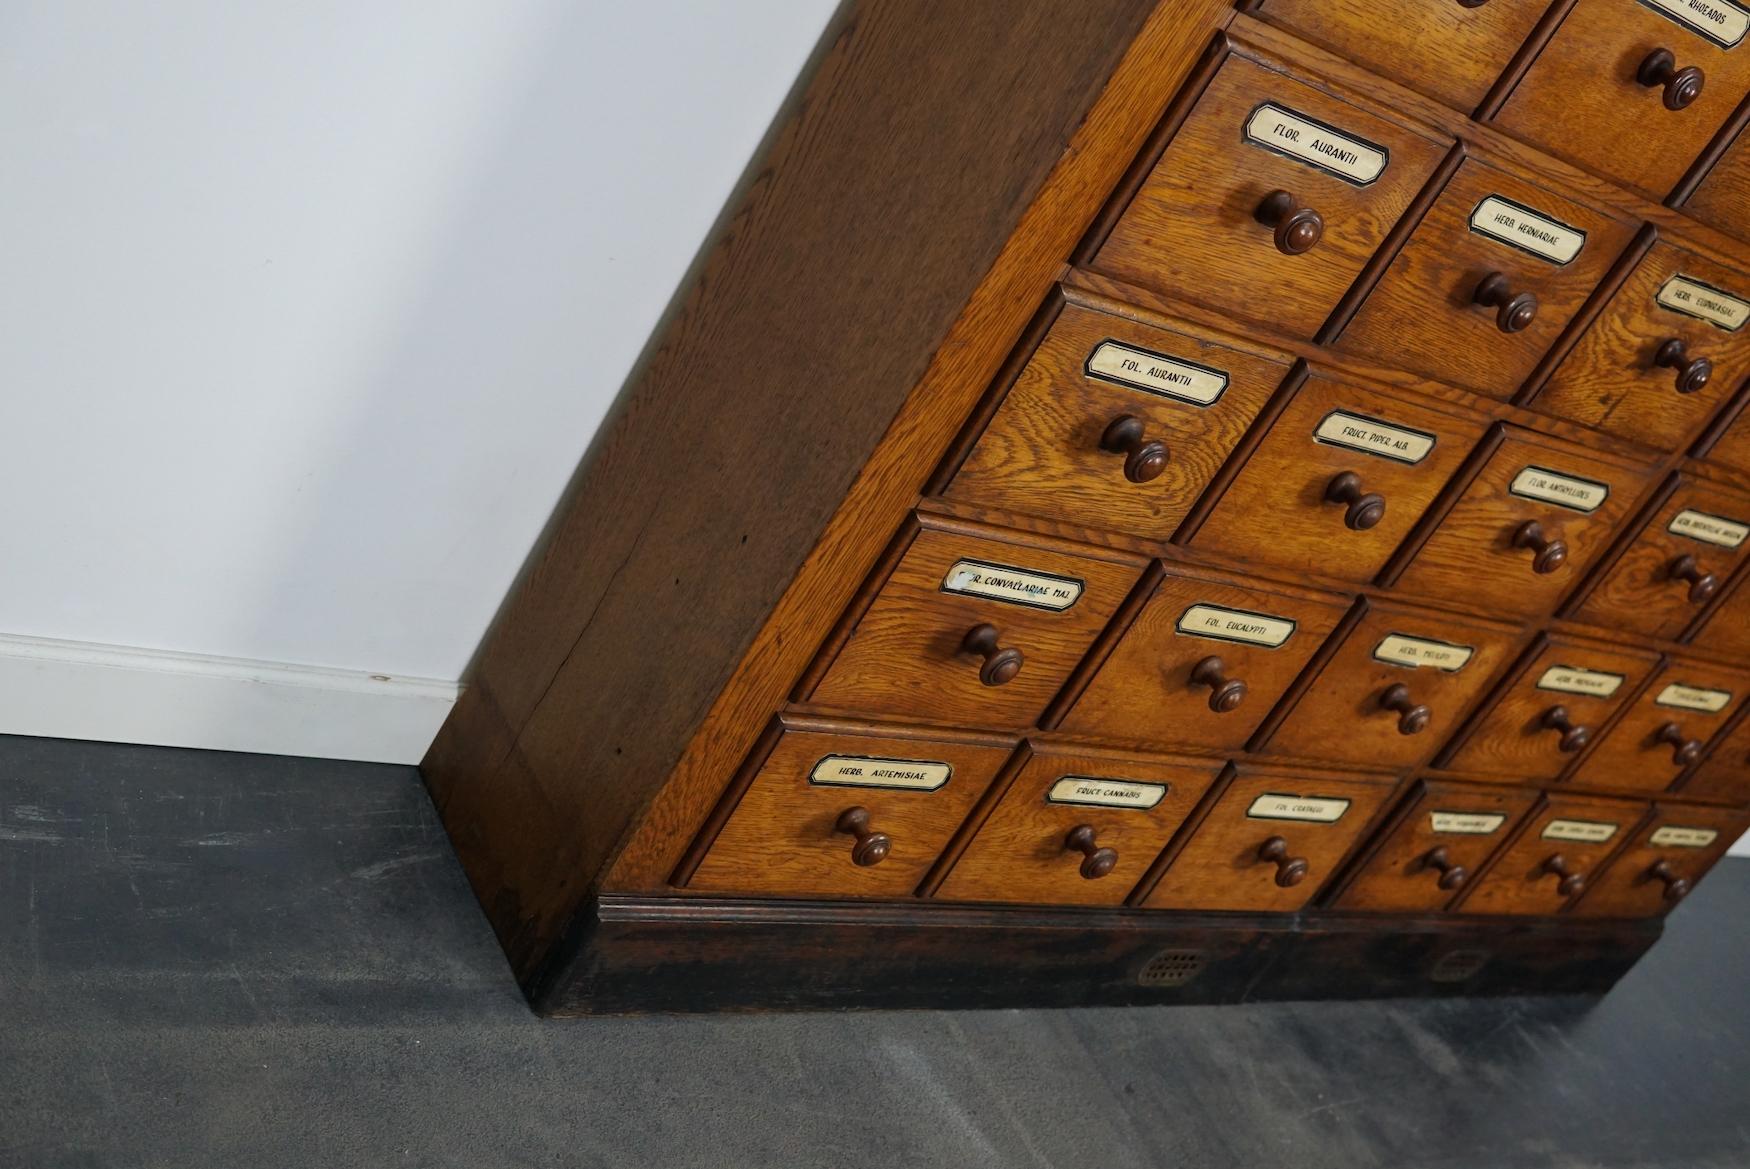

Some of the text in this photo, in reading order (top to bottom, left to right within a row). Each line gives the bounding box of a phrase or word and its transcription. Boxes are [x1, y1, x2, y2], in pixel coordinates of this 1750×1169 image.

[1274, 124, 1358, 165] FLOR. AURANTII
[1518, 222, 1559, 245] HERNIARIAE
[1121, 360, 1192, 386] FOL. AURANTII
[1205, 618, 1267, 635] FOL. EUCALYPTI
[838, 768, 927, 780] HERB. ARTEMISIAE
[1103, 790, 1142, 799] CANNABIS
